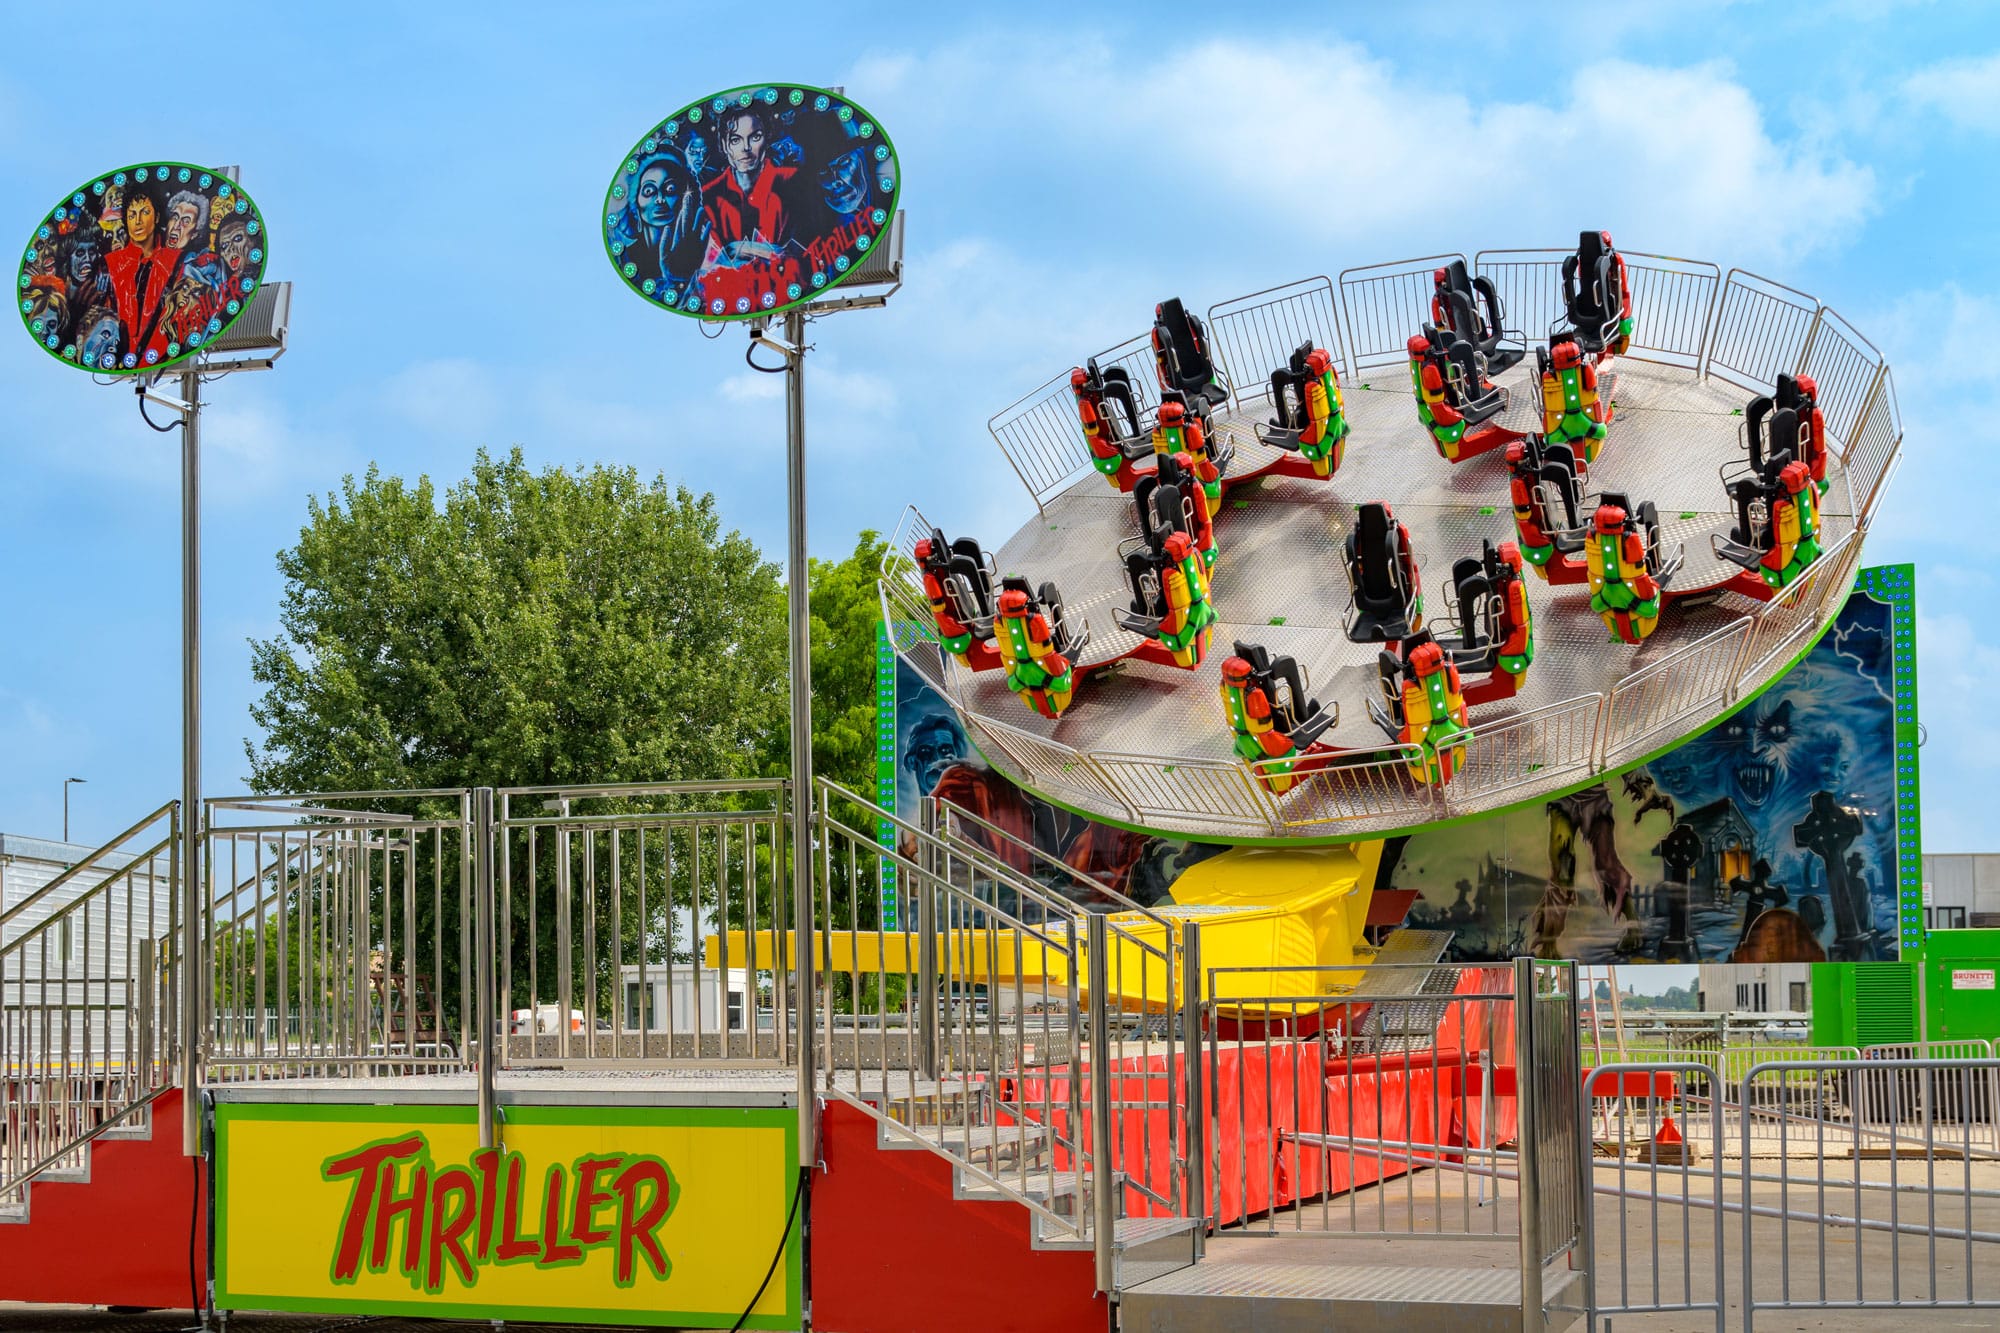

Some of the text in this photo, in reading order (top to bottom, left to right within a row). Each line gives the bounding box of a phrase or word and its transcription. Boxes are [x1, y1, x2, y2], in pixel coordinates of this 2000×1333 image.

[803, 206, 881, 274] THRILLER
[169, 275, 244, 344] THRILLER
[324, 1134, 674, 1291] THRILLER
